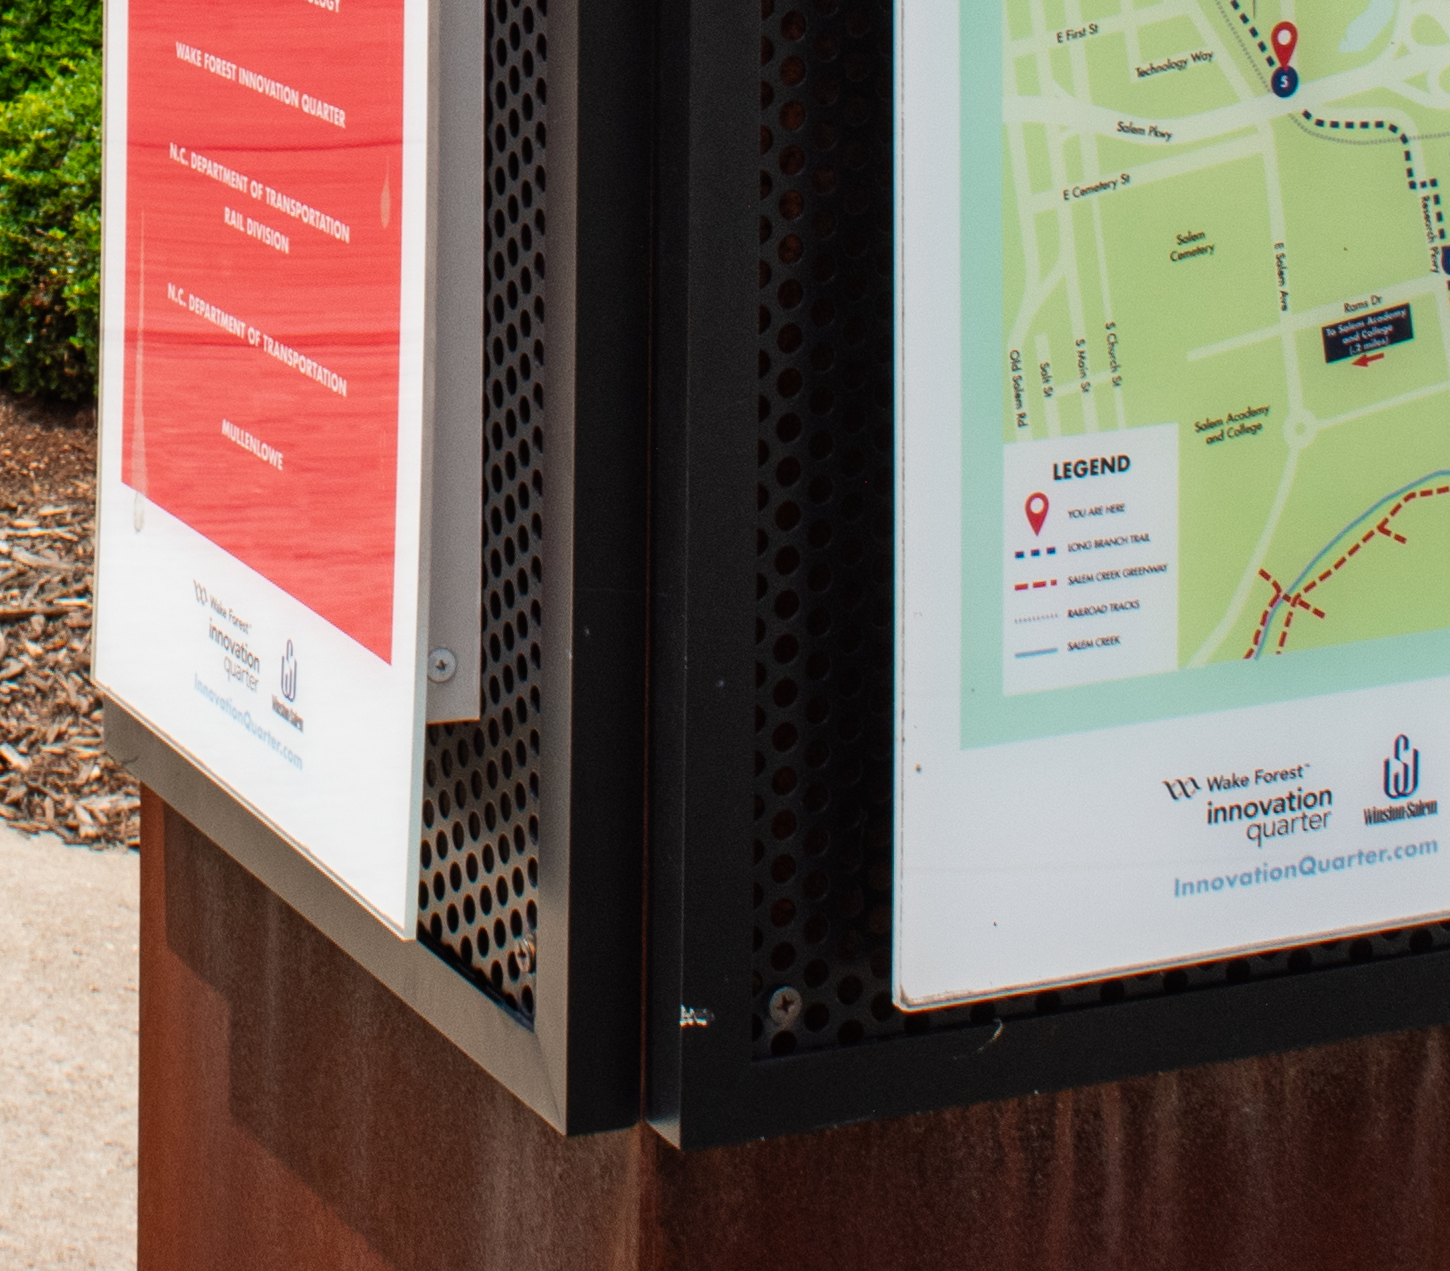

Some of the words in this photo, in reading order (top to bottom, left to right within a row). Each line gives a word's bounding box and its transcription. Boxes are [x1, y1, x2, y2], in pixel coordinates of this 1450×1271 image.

[1135, 57, 1188, 79] Technology
[1190, 50, 1214, 65] Way
[175, 41, 202, 66] WAKE
[204, 50, 236, 82] FOREST
[238, 64, 298, 107] INNOVATION
[301, 93, 346, 129] QUARTER
[1281, 75, 1288, 88] 5
[1116, 121, 1146, 136] Salem
[1148, 125, 1173, 142] Pkwy
[169, 142, 188, 166] N.C.
[190, 151, 248, 193] DEPARTMENT
[250, 179, 263, 199] OF
[265, 186, 350, 244] TRANSPORTATION
[1063, 189, 1070, 201] E
[1072, 180, 1118, 199] Cemetery
[1120, 173, 1131, 186] St
[224, 206, 244, 233] RAIL
[246, 216, 289, 254] DIVISION
[1176, 230, 1206, 245] Salem
[1169, 243, 1216, 262] Cemetery
[167, 282, 186, 307] N.C.
[189, 293, 245, 337] DEPARTMENT
[247, 325, 260, 346] OF
[263, 332, 347, 397] TRANSPORTATION
[1194, 416, 1224, 434] Salem
[1226, 404, 1270, 424] Academy
[222, 419, 283, 471] MULLENLOWE
[1205, 431, 1225, 446] and
[1227, 421, 1263, 440] College
[1053, 454, 1131, 481] LEGEND
[1067, 508, 1087, 520] YOU
[1088, 506, 1104, 517] ARE
[1105, 503, 1126, 515] HERE
[1067, 541, 1091, 553] LONG
[1093, 536, 1128, 549] BRANCH
[1129, 533, 1151, 545] TRAIL
[1067, 573, 1093, 586] SALEM
[1095, 570, 1120, 583] CREEK
[1122, 563, 1168, 579] GREENWAY
[210, 593, 227, 621] Wake
[1067, 604, 1107, 618] RAILROAD
[1108, 599, 1140, 613] TRACKS
[209, 617, 260, 673] innovation
[1067, 639, 1093, 652] SALEM
[1095, 635, 1121, 648] CREEK
[223, 654, 259, 693] quarter
[194, 671, 303, 771] InnovationQuarter.com
[1206, 773, 1250, 792] Wake
[1207, 786, 1332, 825] innovation
[1246, 809, 1332, 848] quarter
[1173, 839, 1439, 898] InnovationQuarter.com
